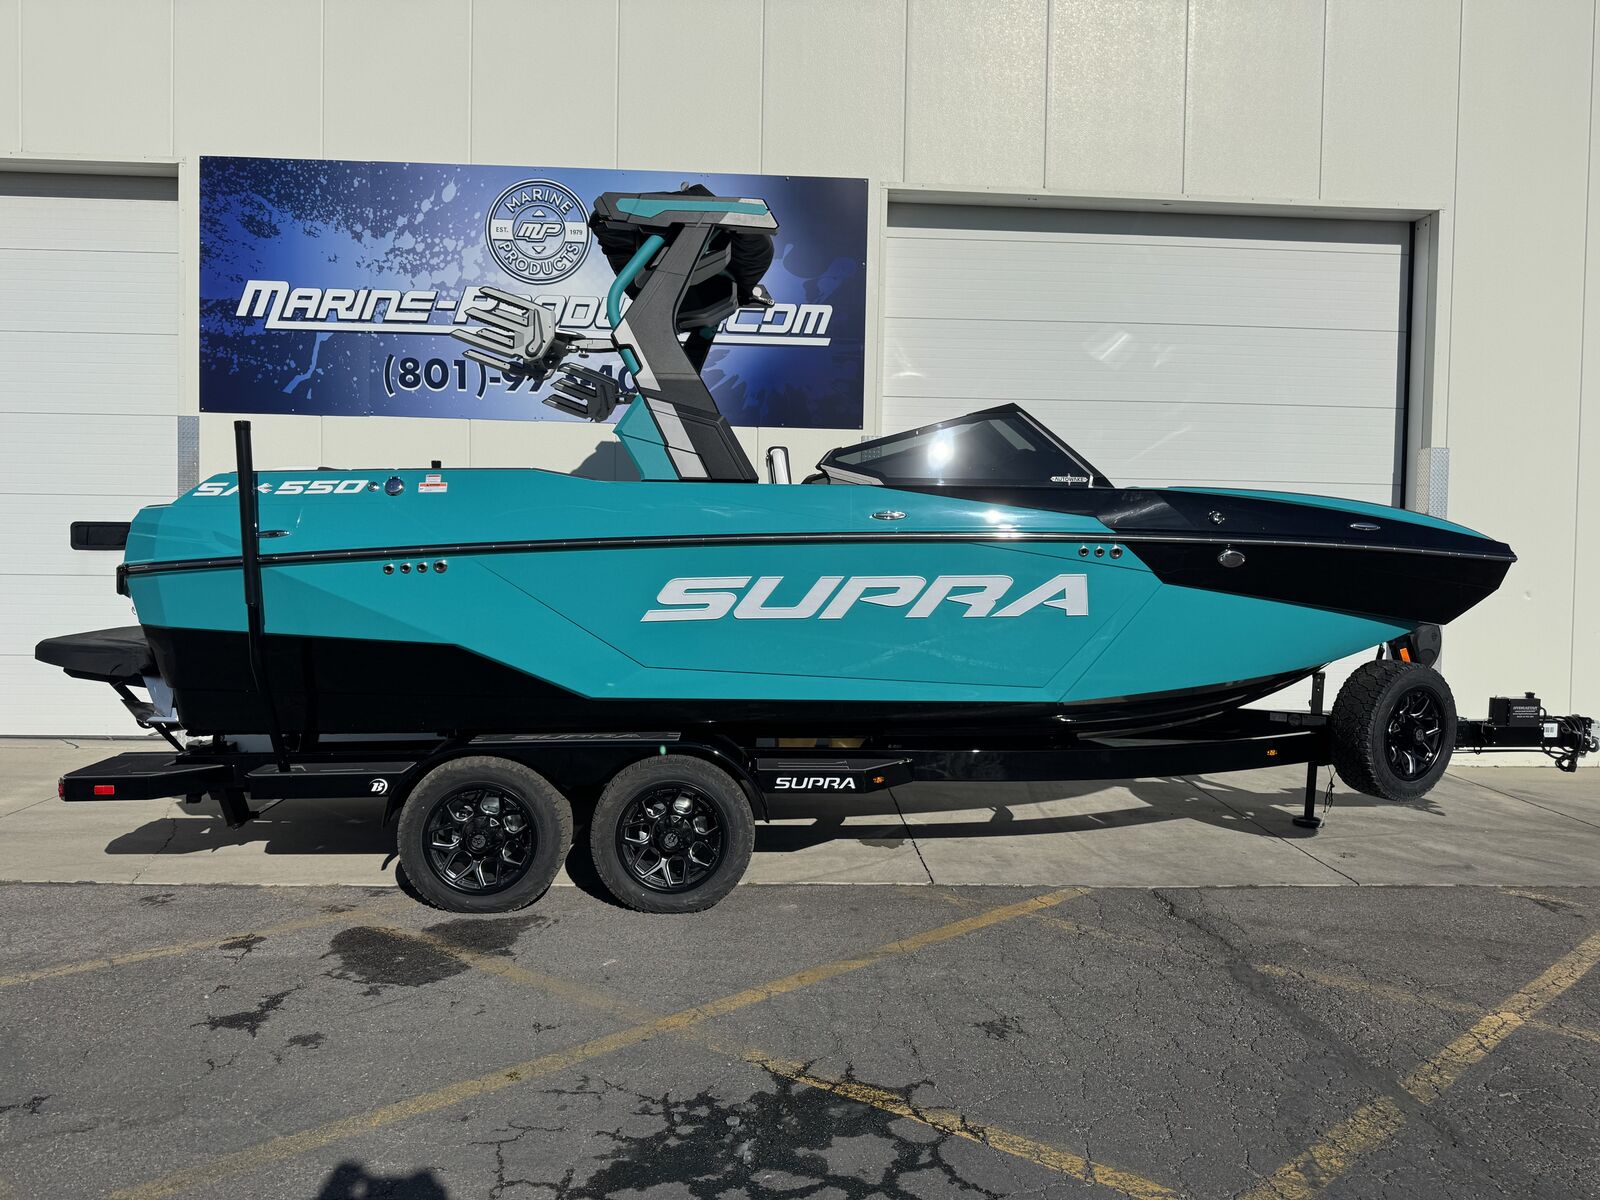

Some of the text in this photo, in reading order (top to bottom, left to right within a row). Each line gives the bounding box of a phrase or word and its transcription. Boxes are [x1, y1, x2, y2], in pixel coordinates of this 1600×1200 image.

[504, 188, 574, 215] MARINE
[498, 241, 580, 275] PRODUCTS
[273, 479, 369, 495] 550
[640, 573, 1089, 622] SUPRA
[774, 777, 856, 789] SUPRA
